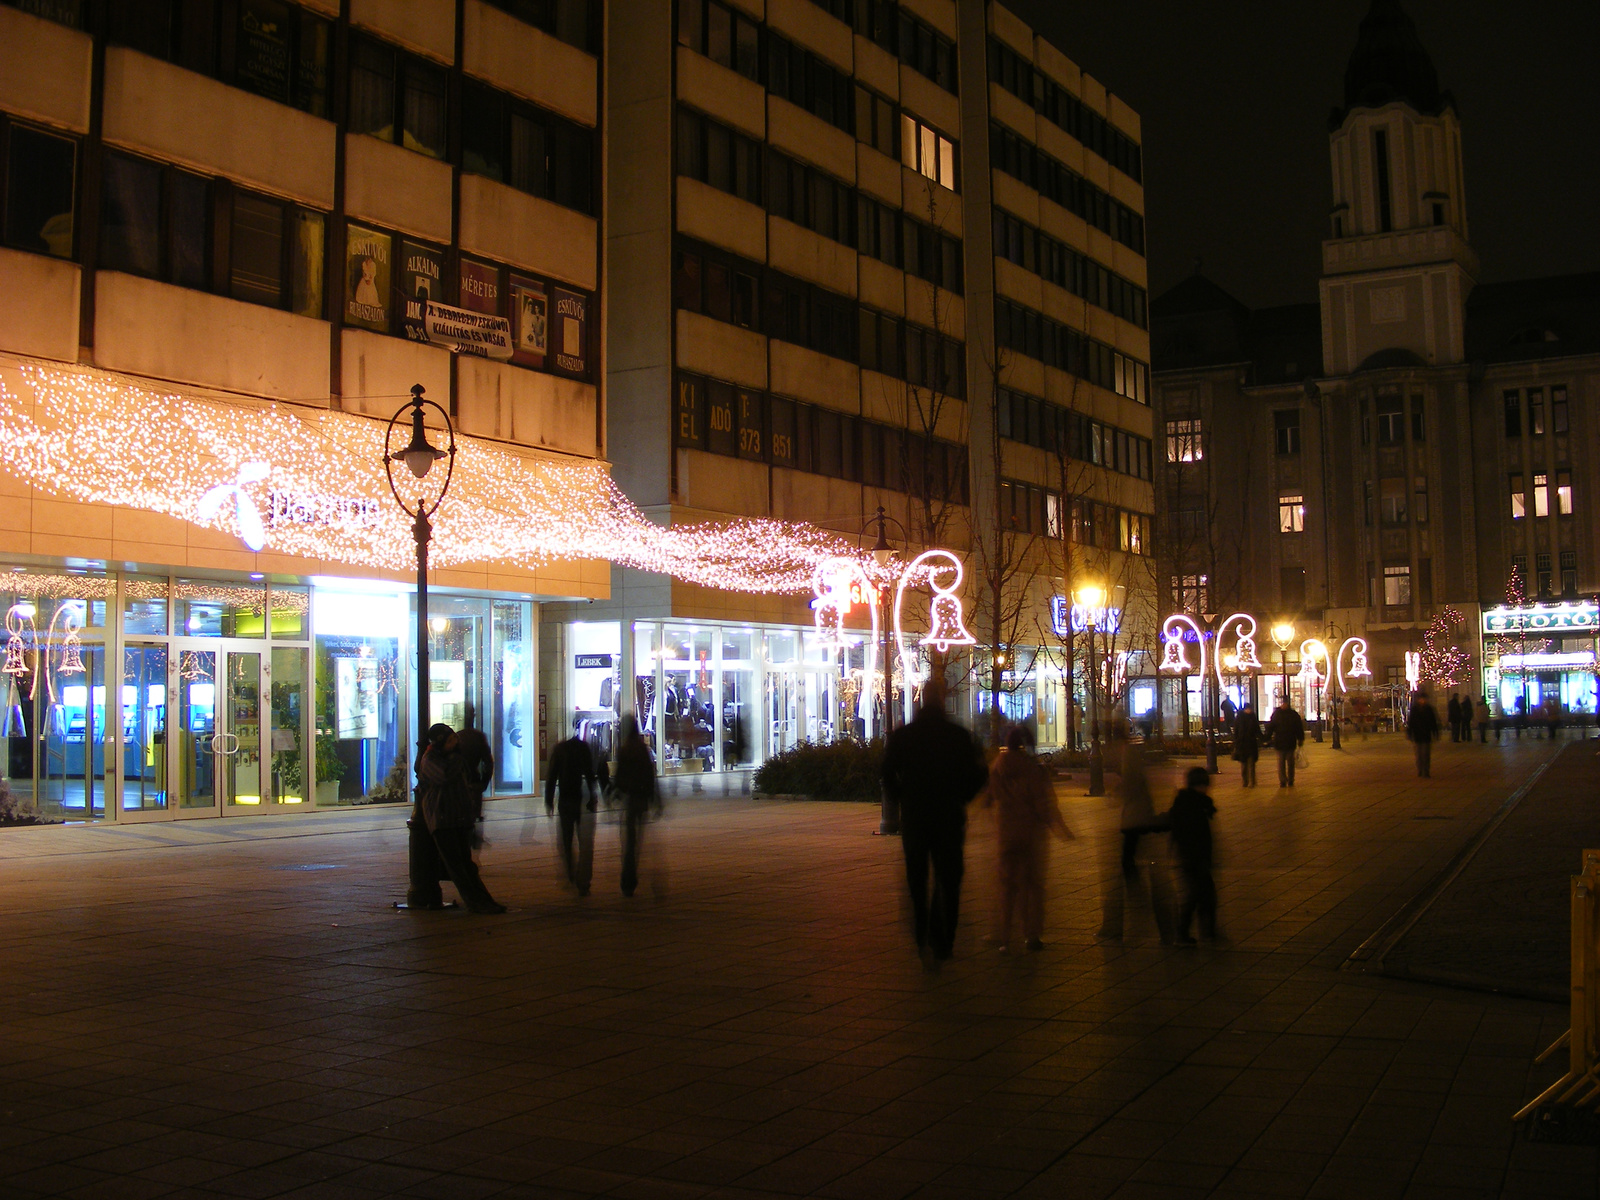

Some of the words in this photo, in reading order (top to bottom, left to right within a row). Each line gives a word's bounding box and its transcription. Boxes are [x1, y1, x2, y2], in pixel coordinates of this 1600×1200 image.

[407, 256, 440, 280] ALKALMI
[461, 274, 498, 298] MÉRETES
[349, 301, 385, 322] RUHASZALON
[406, 300, 422, 320] JAN.
[437, 306, 478, 327] DEBRECENI
[432, 321, 471, 341] KIÁLLÍTÁS
[471, 327, 482, 342] ÉS
[481, 331, 507, 348] VÁSÁR
[557, 353, 585, 372] RUHASZALON
[710, 403, 732, 432] ADÓ
[740, 428, 760, 454] 373
[773, 433, 791, 459] 851
